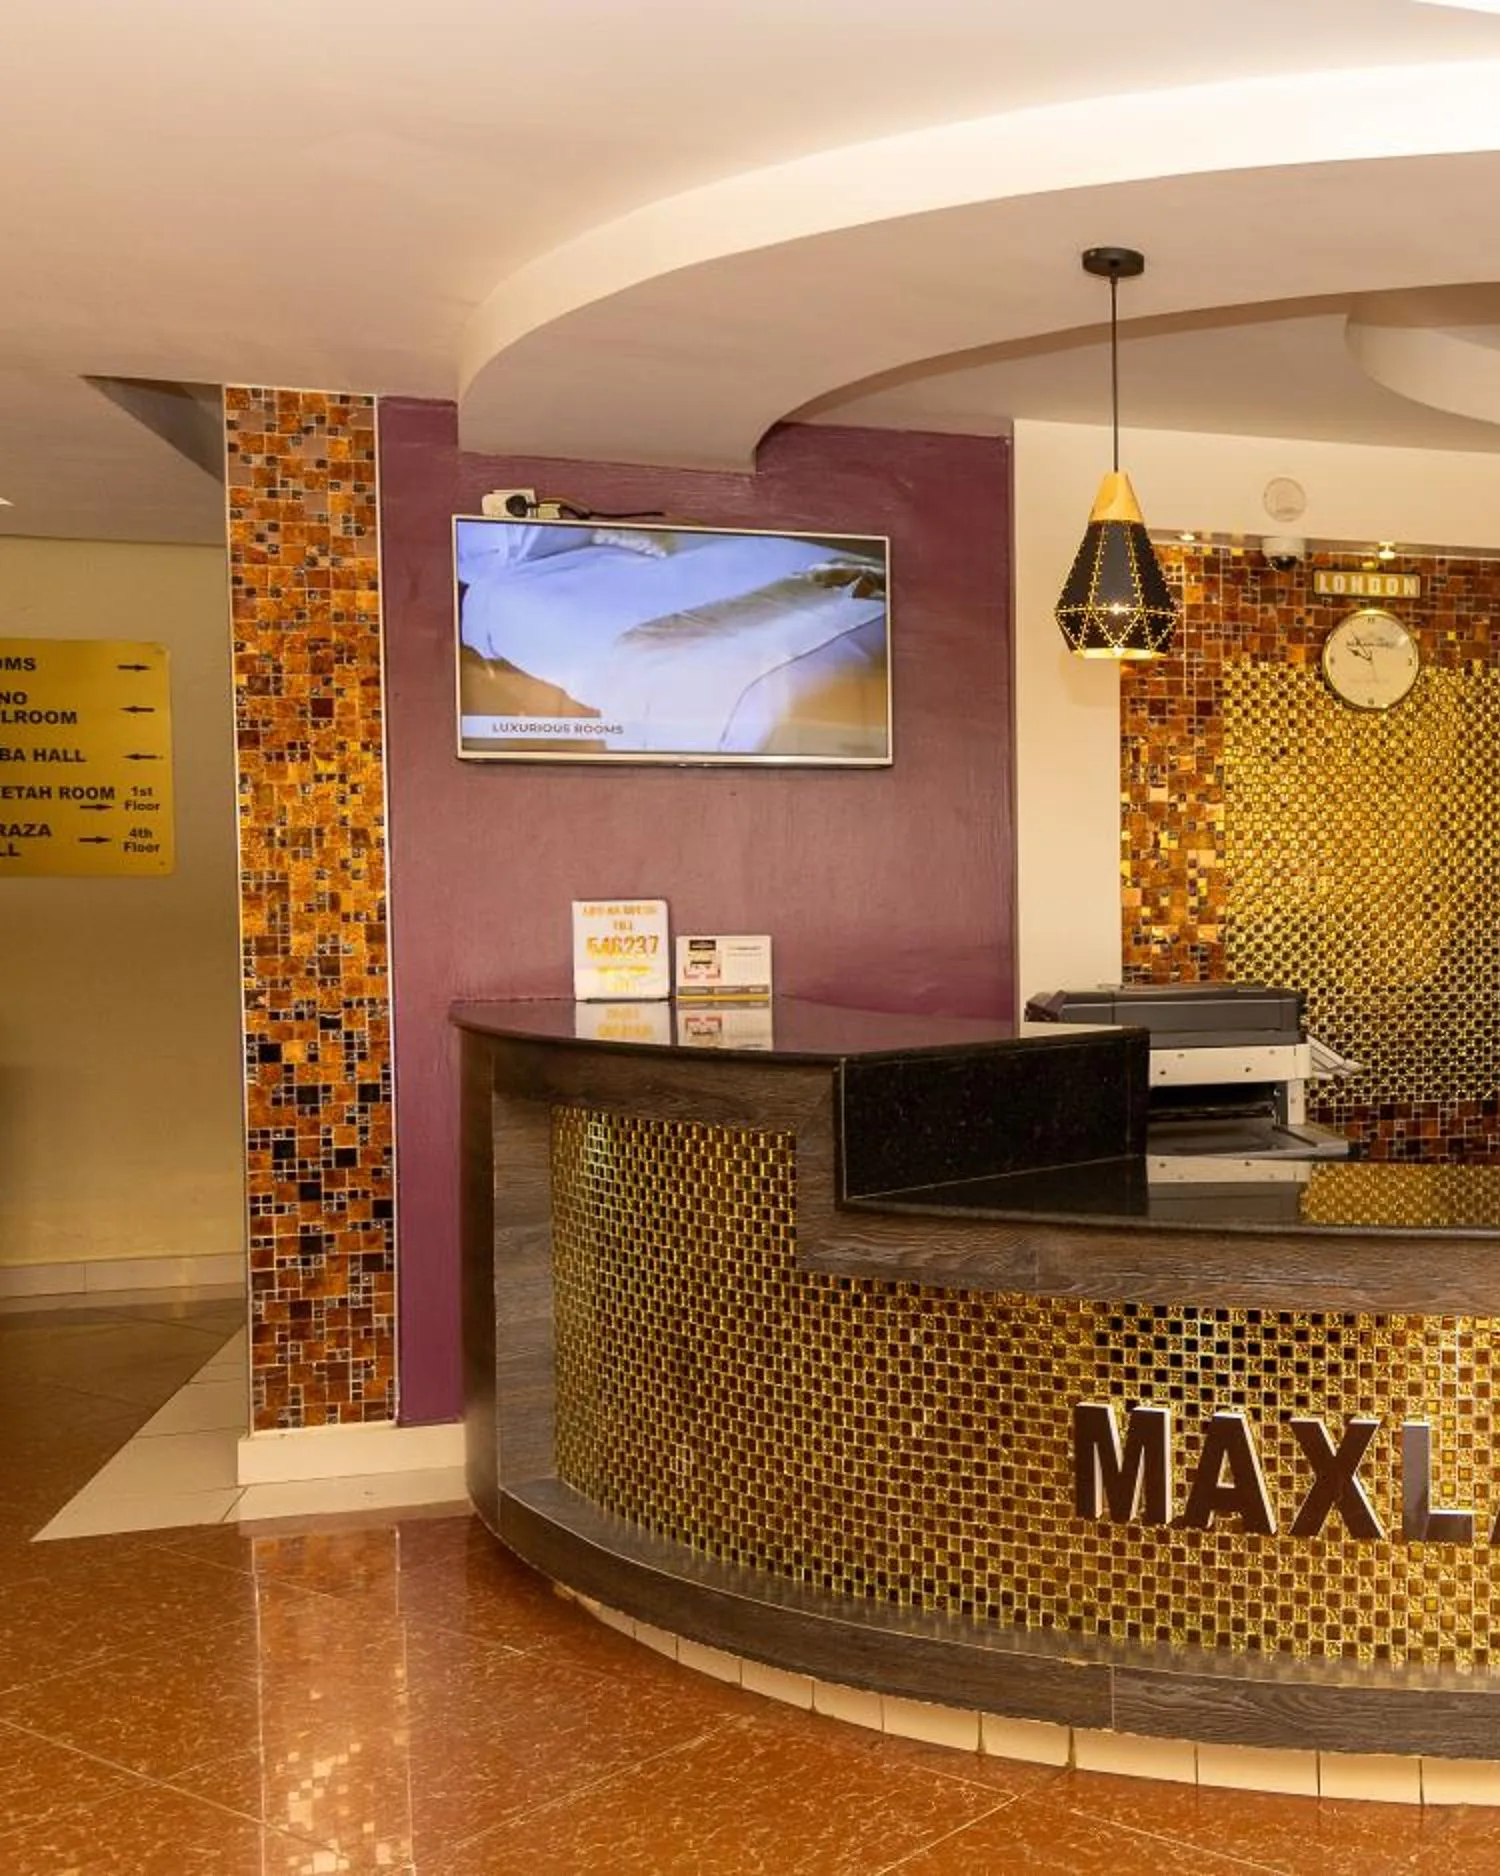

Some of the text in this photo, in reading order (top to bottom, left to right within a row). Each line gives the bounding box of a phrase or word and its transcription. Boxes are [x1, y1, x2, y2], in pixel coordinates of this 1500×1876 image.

[1319, 573, 1417, 597] LONDON
[0, 656, 37, 671] MS
[1, 710, 77, 725] LROOM
[492, 722, 624, 734] LUXURIOUS ROOMS
[33, 748, 87, 763] HALL
[1, 786, 115, 800] ETAH ROOM
[130, 786, 153, 797] 1st
[124, 800, 161, 811] Floor
[128, 827, 153, 839] 4th
[123, 841, 161, 853] Floor
